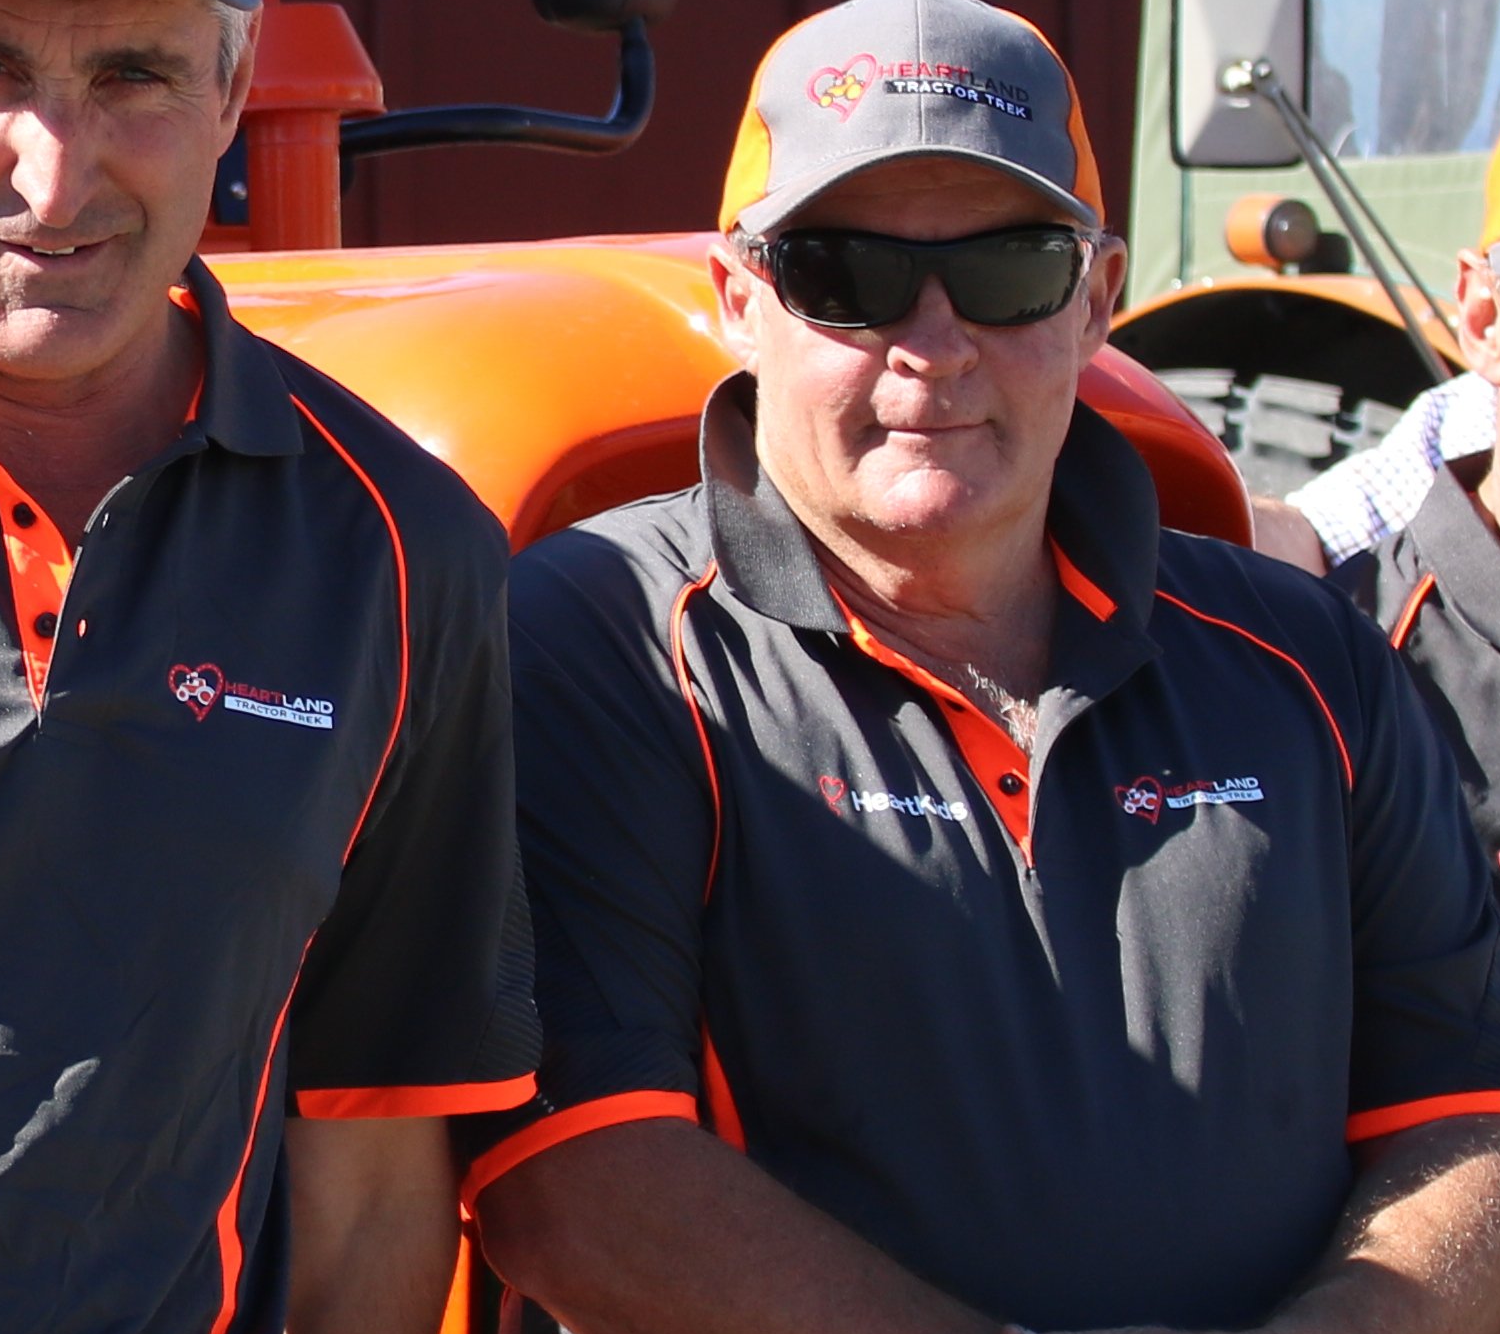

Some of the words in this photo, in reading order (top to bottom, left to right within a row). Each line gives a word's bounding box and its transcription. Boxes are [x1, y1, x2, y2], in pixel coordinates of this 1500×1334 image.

[877, 60, 1030, 103] HEARTLAND
[893, 80, 980, 103] TRACTOR
[984, 93, 1027, 119] TREK
[224, 681, 334, 714] HEARTLAND
[234, 698, 288, 718] TRACTOR
[291, 712, 323, 725] TREK
[851, 790, 968, 821] HeartKids
[1227, 790, 1254, 800] TREK
